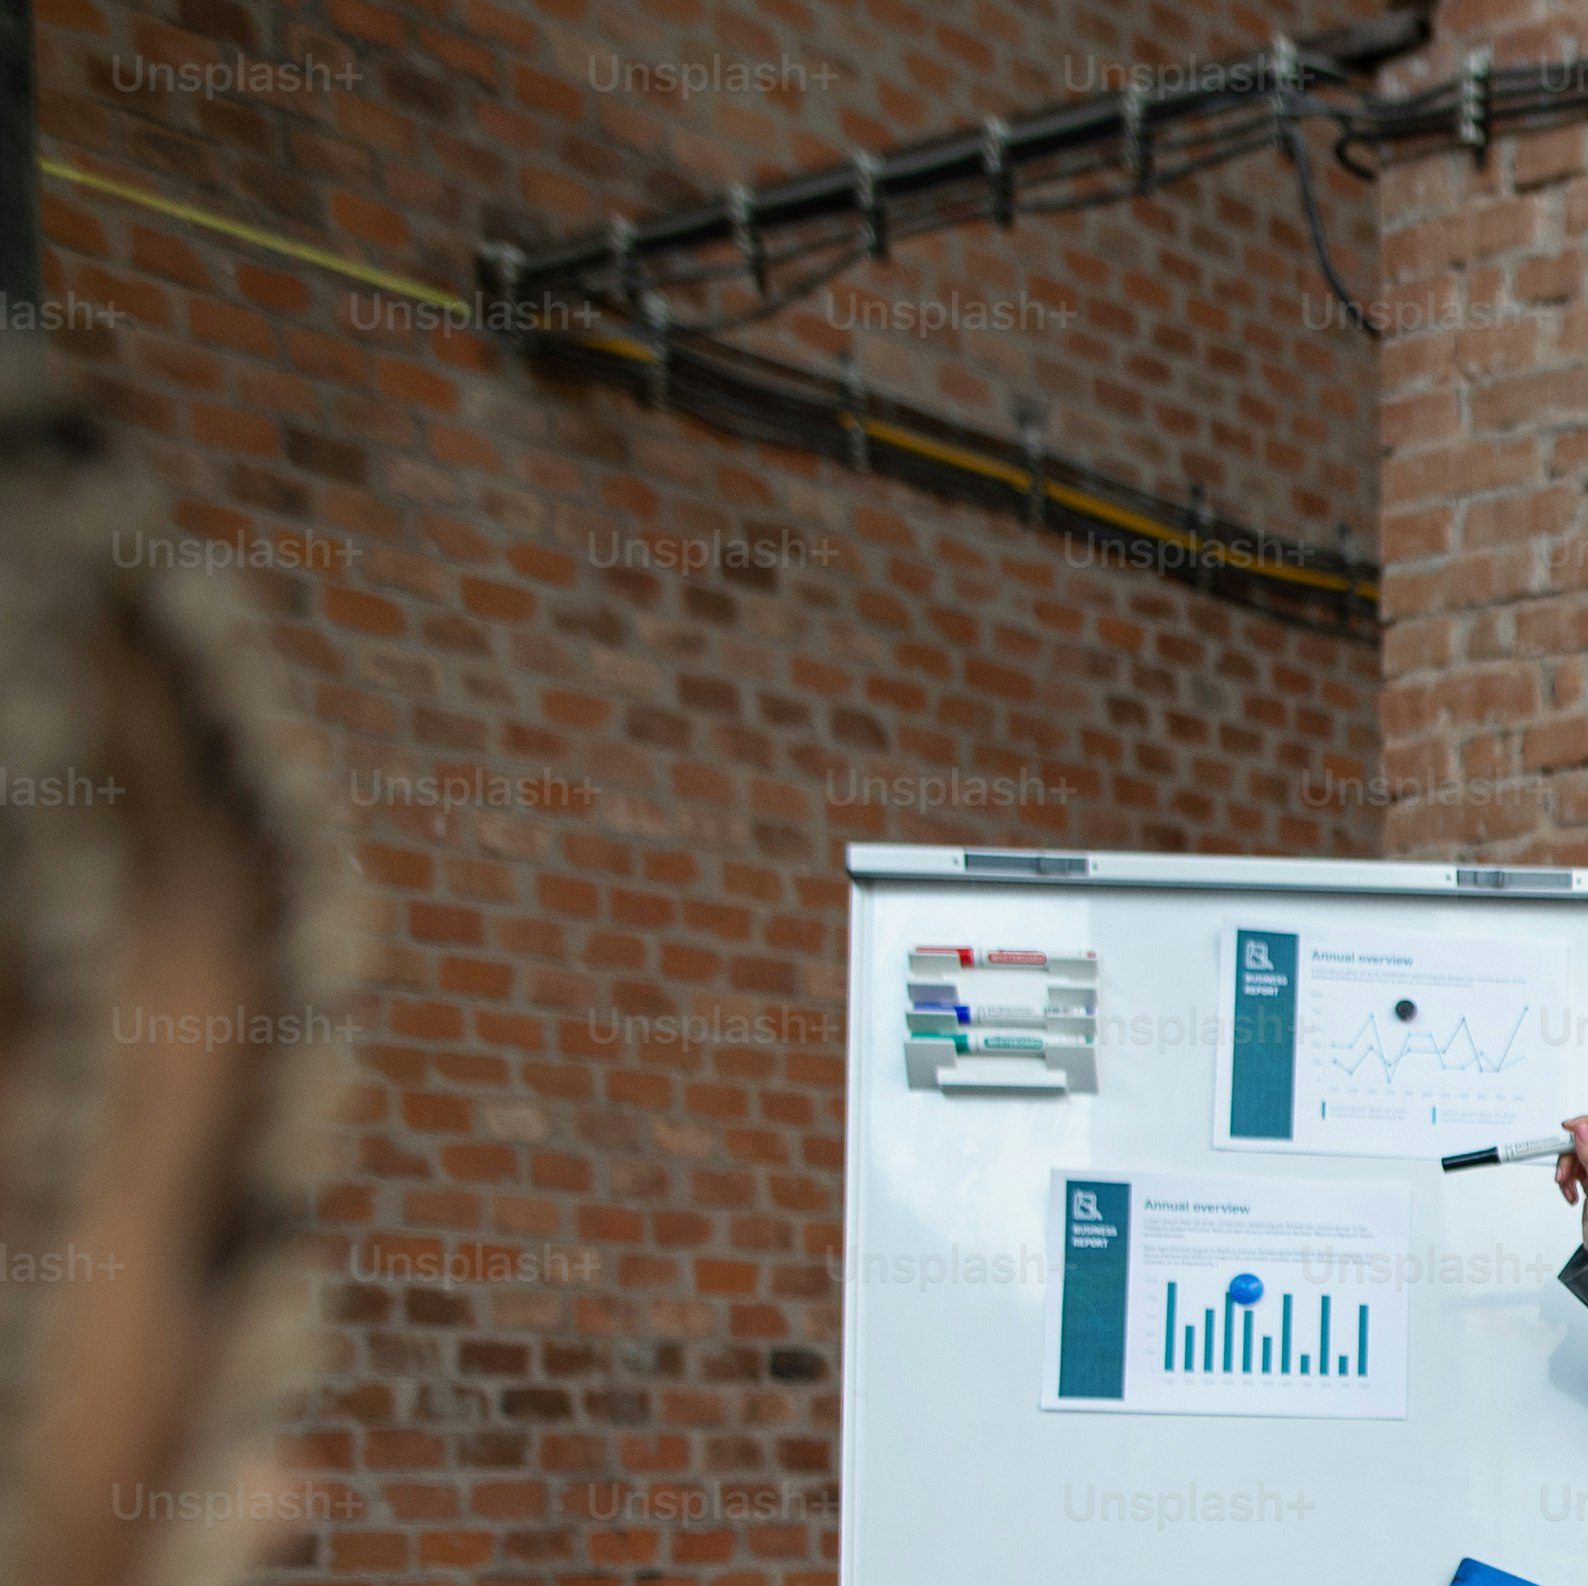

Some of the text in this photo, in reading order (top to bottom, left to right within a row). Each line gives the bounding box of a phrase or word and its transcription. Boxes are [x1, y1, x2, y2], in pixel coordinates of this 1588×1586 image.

[1311, 949, 1415, 967] Annual overview
[1243, 972, 1289, 986] BUSINESS
[1243, 985, 1280, 997] REPORT
[1144, 1198, 1251, 1216] Annual overview
[1071, 1222, 1119, 1237] BUSINESS
[1071, 1236, 1110, 1249] REPORT
